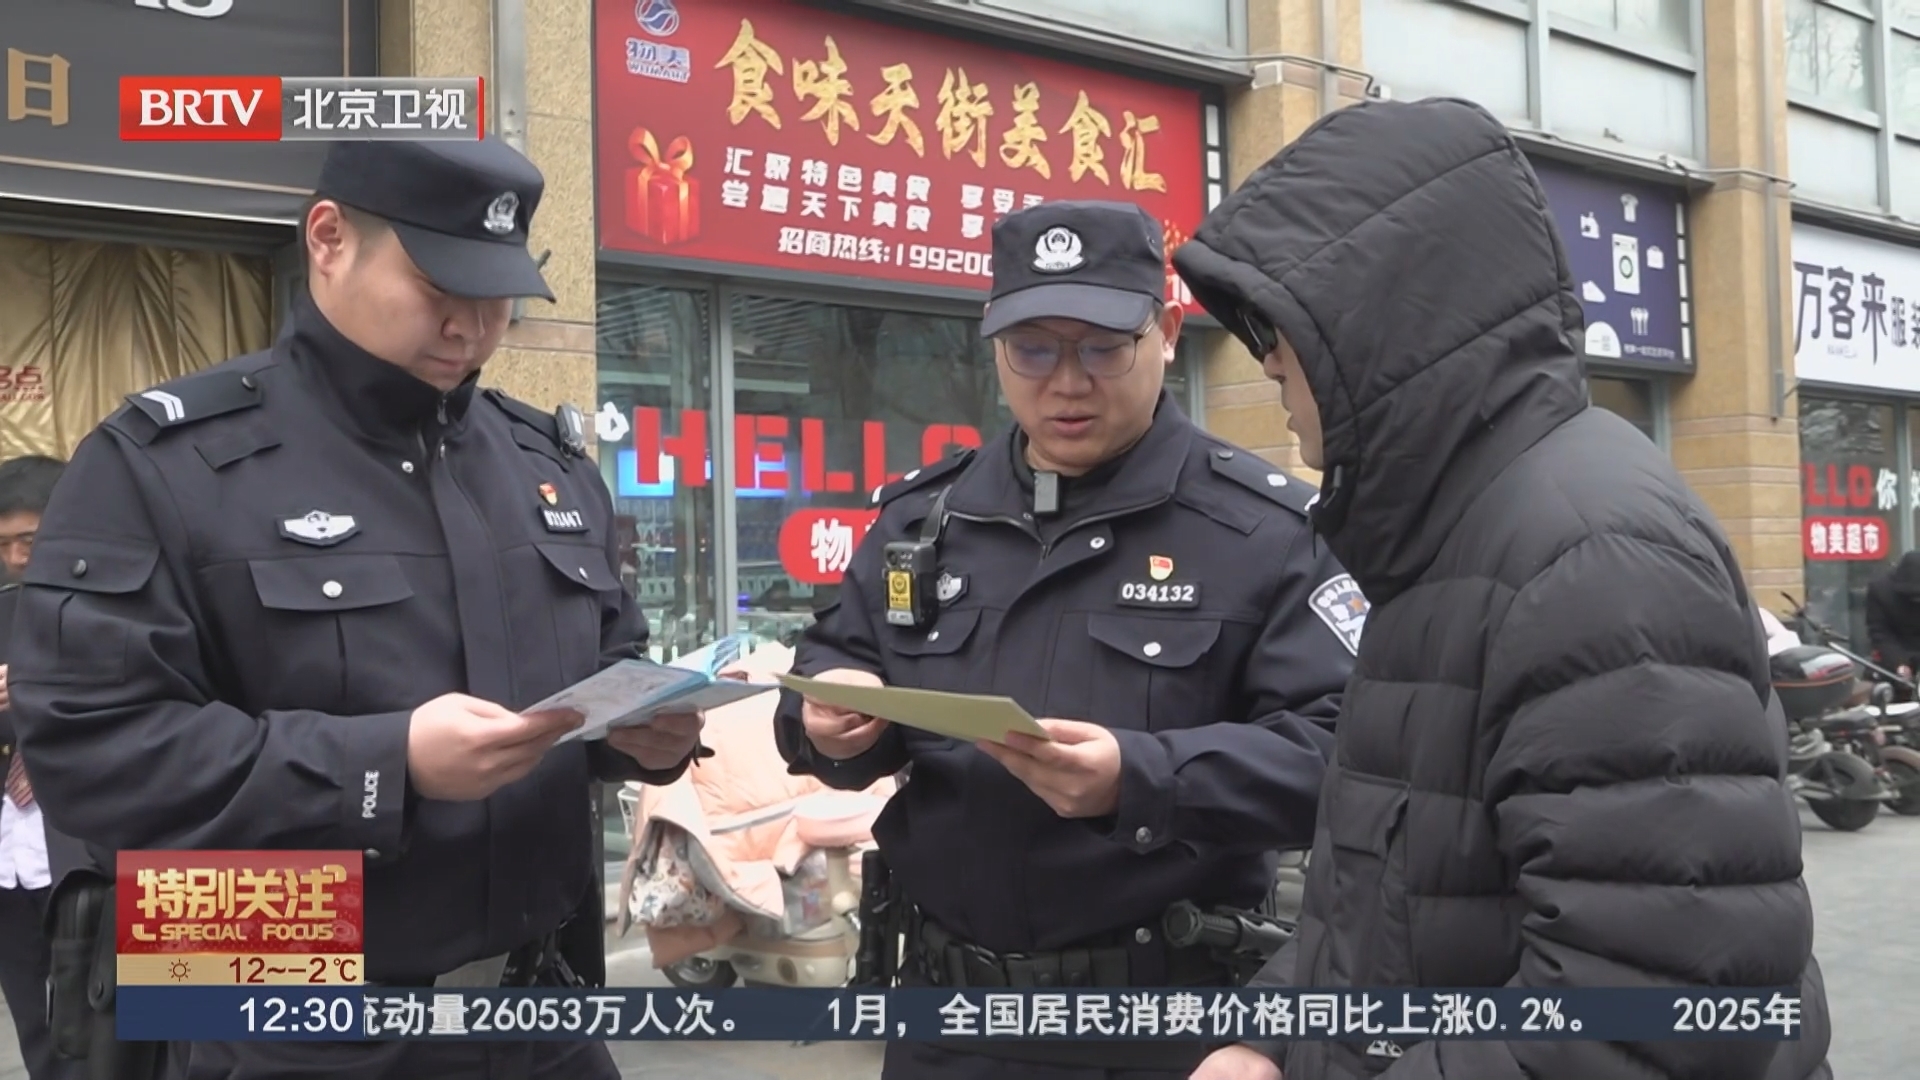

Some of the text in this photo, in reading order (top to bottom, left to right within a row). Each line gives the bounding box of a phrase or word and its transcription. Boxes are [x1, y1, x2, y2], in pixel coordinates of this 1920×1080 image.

[715, 18, 1168, 194] 食味天街美食汇
[724, 146, 931, 202] 汇聚特色美食
[1121, 582, 1195, 603] 034132
[362, 769, 380, 818] POLICE
